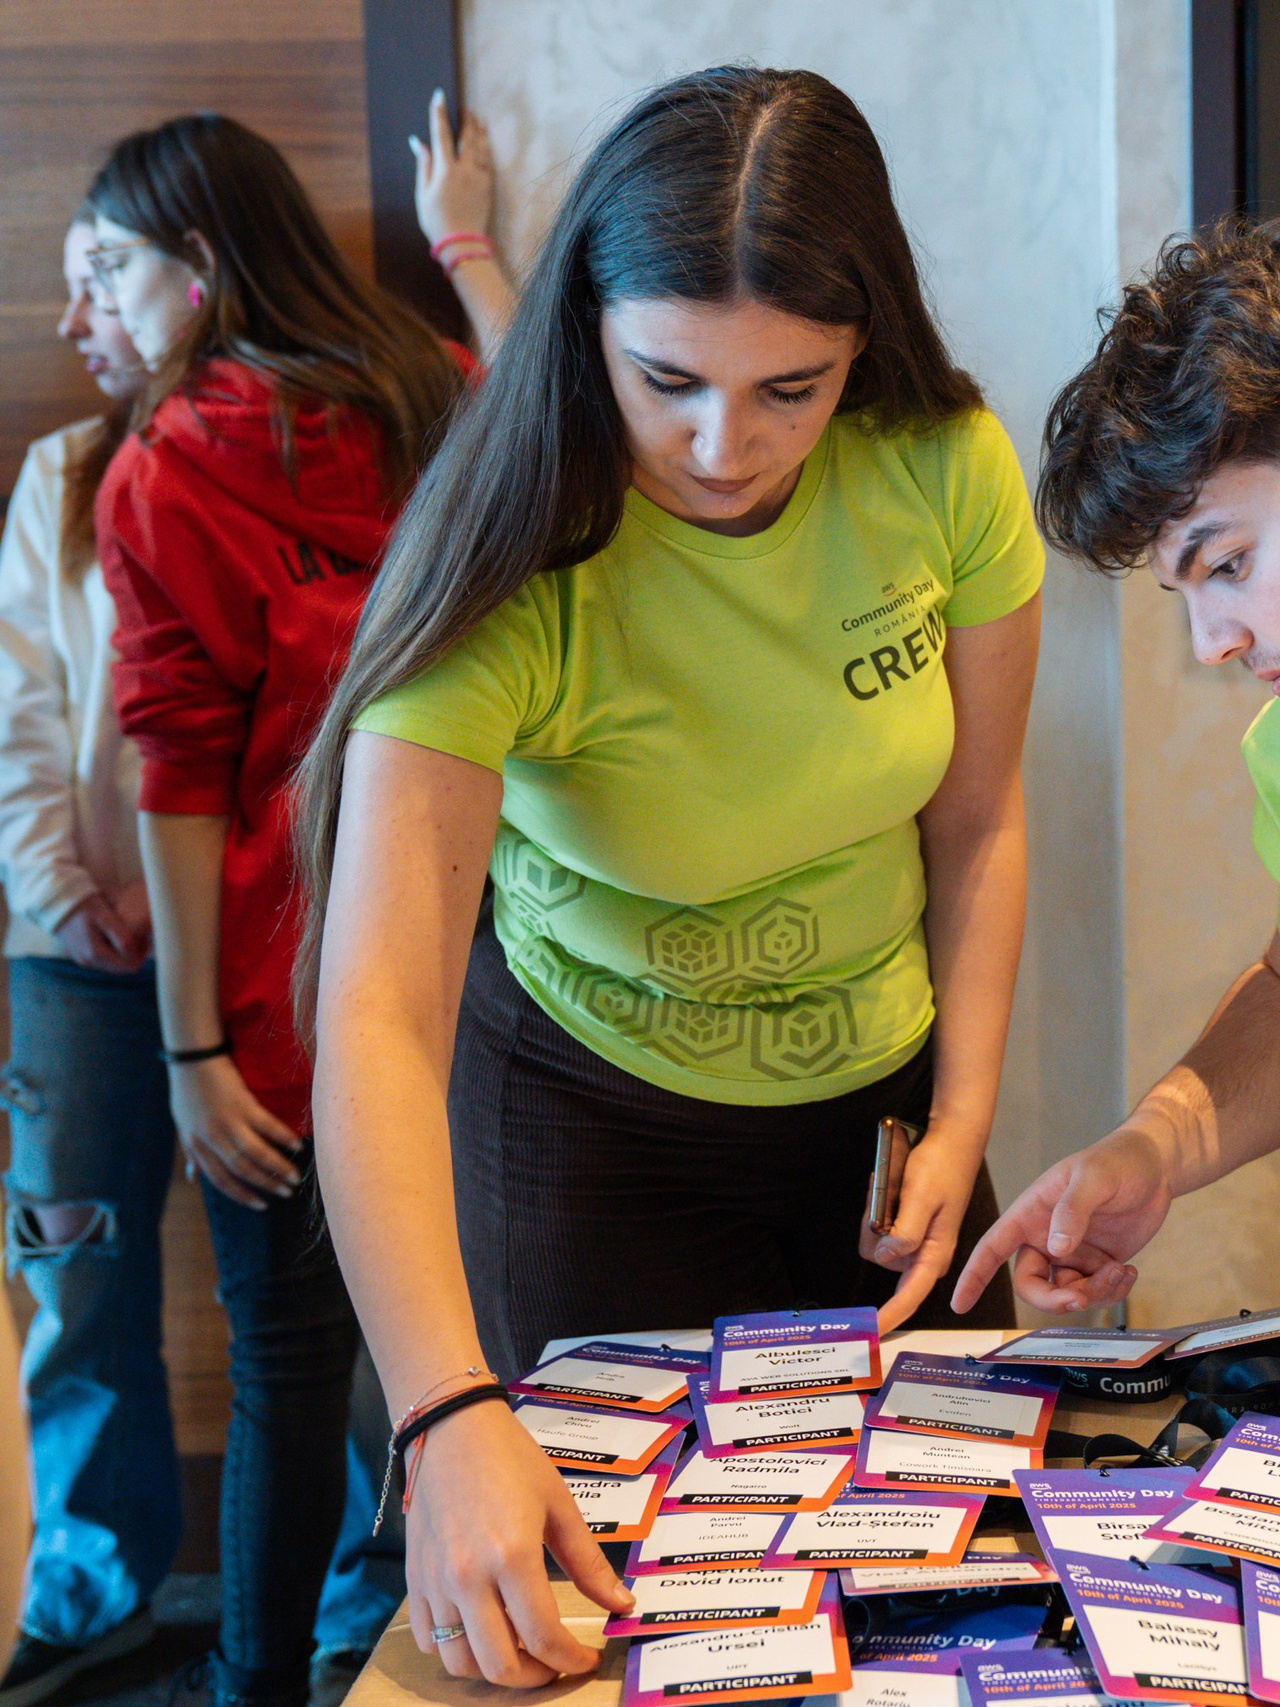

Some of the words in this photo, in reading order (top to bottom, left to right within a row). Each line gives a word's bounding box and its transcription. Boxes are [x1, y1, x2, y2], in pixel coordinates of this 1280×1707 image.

[881, 582, 895, 594] aws
[841, 591, 915, 632] Community
[913, 579, 935, 597] Day
[874, 605, 926, 637] ROMÂNIA
[843, 604, 943, 701] CREW
[723, 1324, 816, 1338] Community
[820, 1323, 850, 1331] Day
[582, 1347, 670, 1361] Community
[670, 1356, 701, 1364] Day
[755, 1347, 836, 1359] Albulesci
[1020, 1355, 1107, 1363] PARTICIPANT
[769, 1356, 823, 1366] Victor
[783, 1370, 832, 1378] SOLUTIONS
[900, 1364, 995, 1380] Community
[1000, 1374, 1031, 1384] Day
[750, 1378, 841, 1393] PARTICIPANT
[544, 1385, 631, 1401] PARTICIPANT
[931, 1392, 991, 1403] Andruhovici
[735, 1397, 830, 1413] Alexandru
[759, 1406, 812, 1418] Botici
[939, 1408, 972, 1417] Eviden
[567, 1416, 600, 1424] Andrei
[909, 1418, 1002, 1436] PARTICIPANT
[537, 1428, 567, 1437] Haufe
[568, 1433, 599, 1441] Group
[746, 1430, 840, 1446] PARTICIPANT
[711, 1456, 827, 1466] Apostolovici
[922, 1451, 971, 1459] Muntean
[722, 1465, 800, 1474] Radmila
[899, 1461, 939, 1469] Cowork
[899, 1473, 998, 1486] PARTICIPANT
[1031, 1490, 1136, 1500] Community
[1141, 1489, 1175, 1499] Day
[817, 1510, 941, 1520] Alexandroiu
[699, 1533, 749, 1541] IDEAHUB
[808, 1550, 914, 1559] PARTICIPANT
[660, 1577, 721, 1587] David
[728, 1576, 785, 1585] Ionut
[1069, 1573, 1182, 1597] Community
[1186, 1588, 1222, 1604] Day
[655, 1609, 765, 1622] PARTICIPANT
[1138, 1619, 1218, 1639] Balassy
[708, 1639, 765, 1653] Ursei
[958, 1634, 996, 1650] Day
[1149, 1634, 1221, 1651] Mihaly
[680, 1674, 797, 1693] PARTICIPANT
[881, 1689, 907, 1697] Alex
